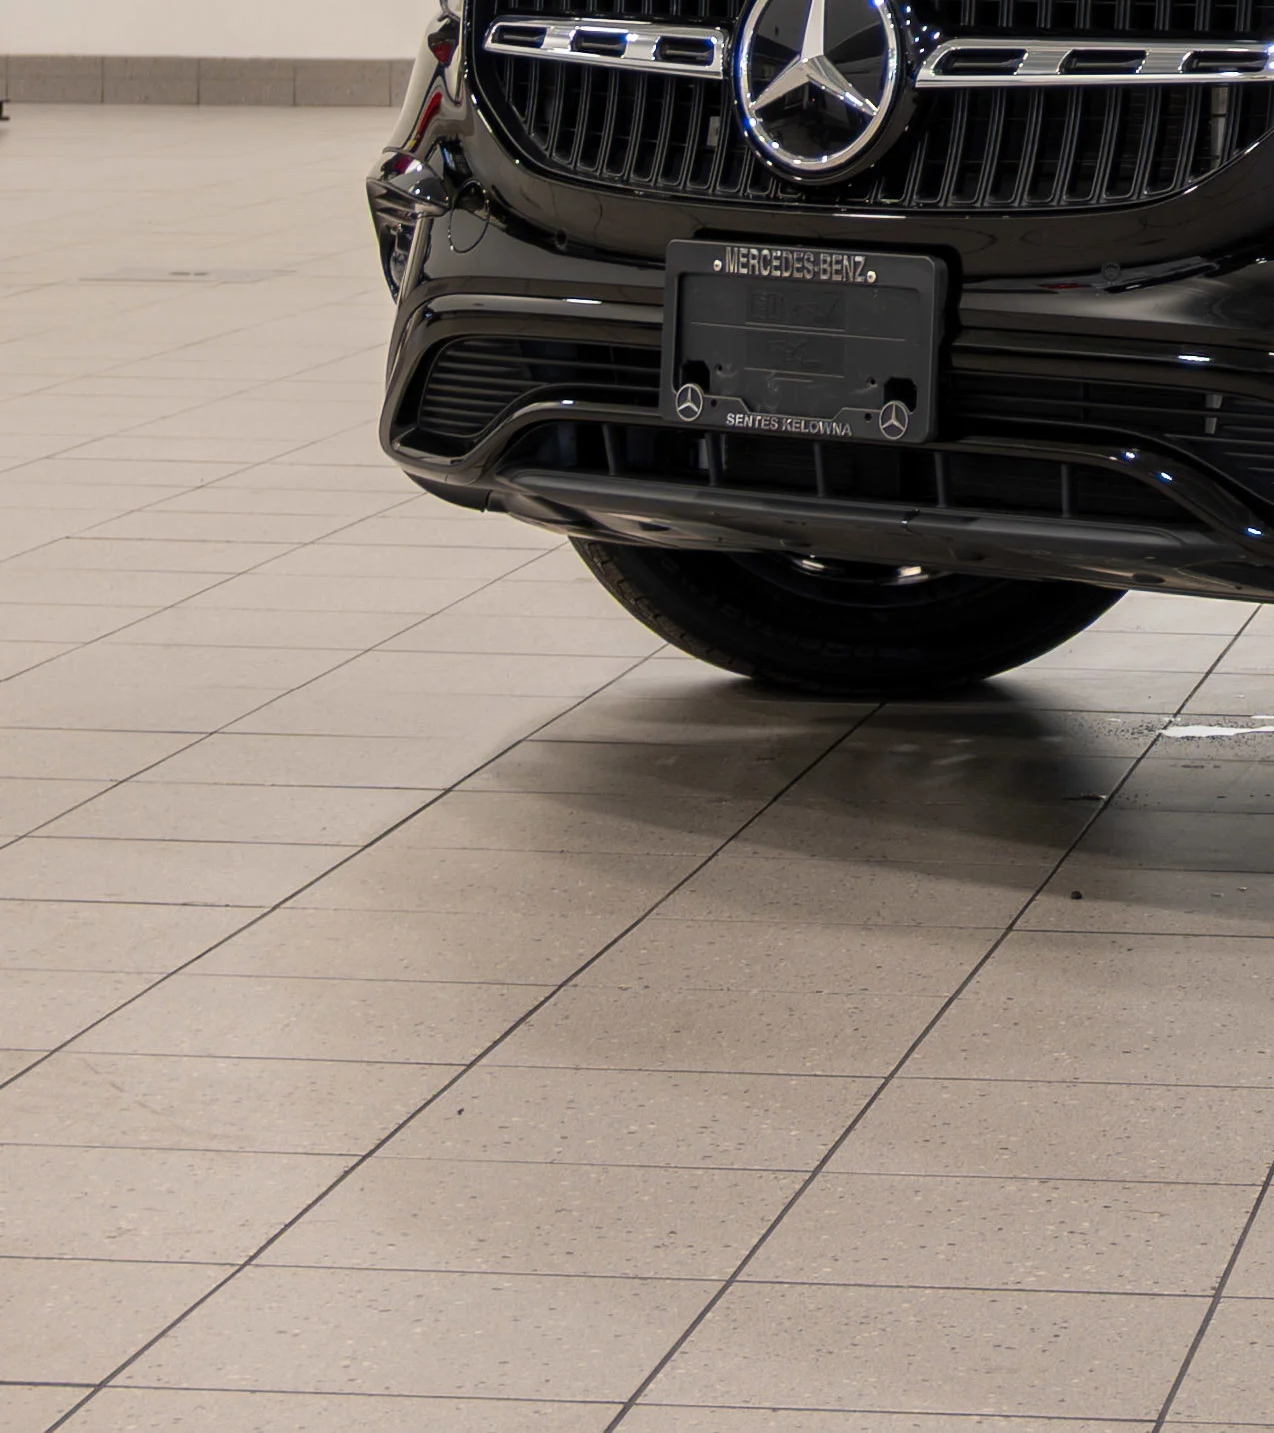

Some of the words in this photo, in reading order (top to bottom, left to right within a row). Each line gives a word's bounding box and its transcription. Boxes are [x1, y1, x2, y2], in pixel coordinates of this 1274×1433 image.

[725, 246, 867, 283] MERCEDES-BENZ
[726, 413, 779, 432] SENTES
[781, 415, 853, 437] KELOWNA
